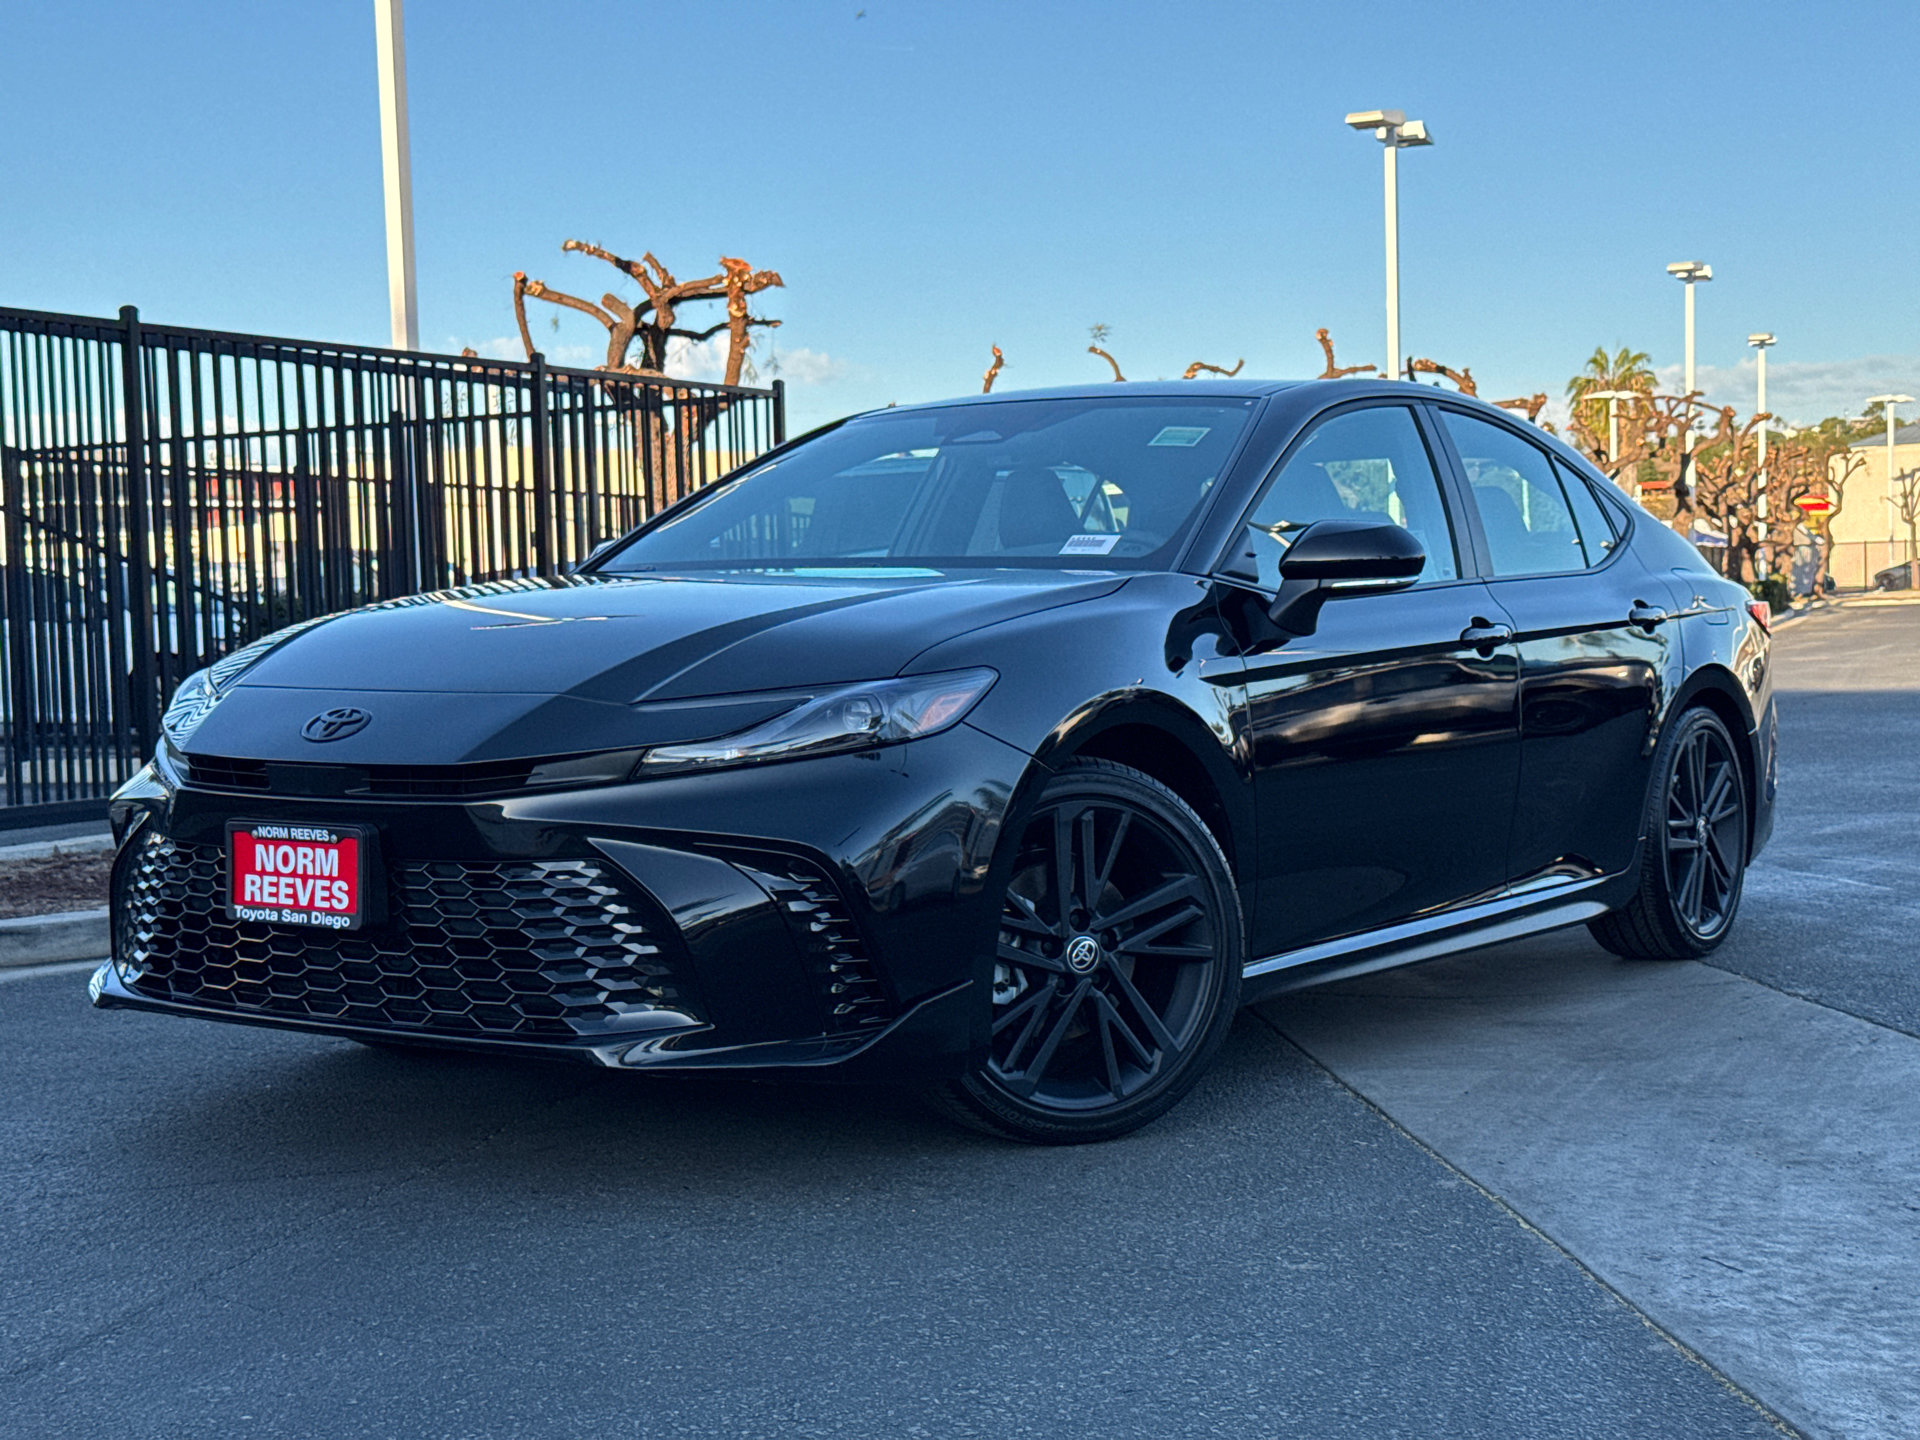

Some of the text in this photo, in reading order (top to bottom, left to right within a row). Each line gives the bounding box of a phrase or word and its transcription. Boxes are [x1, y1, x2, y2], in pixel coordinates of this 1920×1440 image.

[257, 826, 330, 842] NORM REEVES
[255, 844, 339, 877] NORM
[244, 874, 349, 910] REEVES
[234, 905, 350, 929] Toyota San Diego
